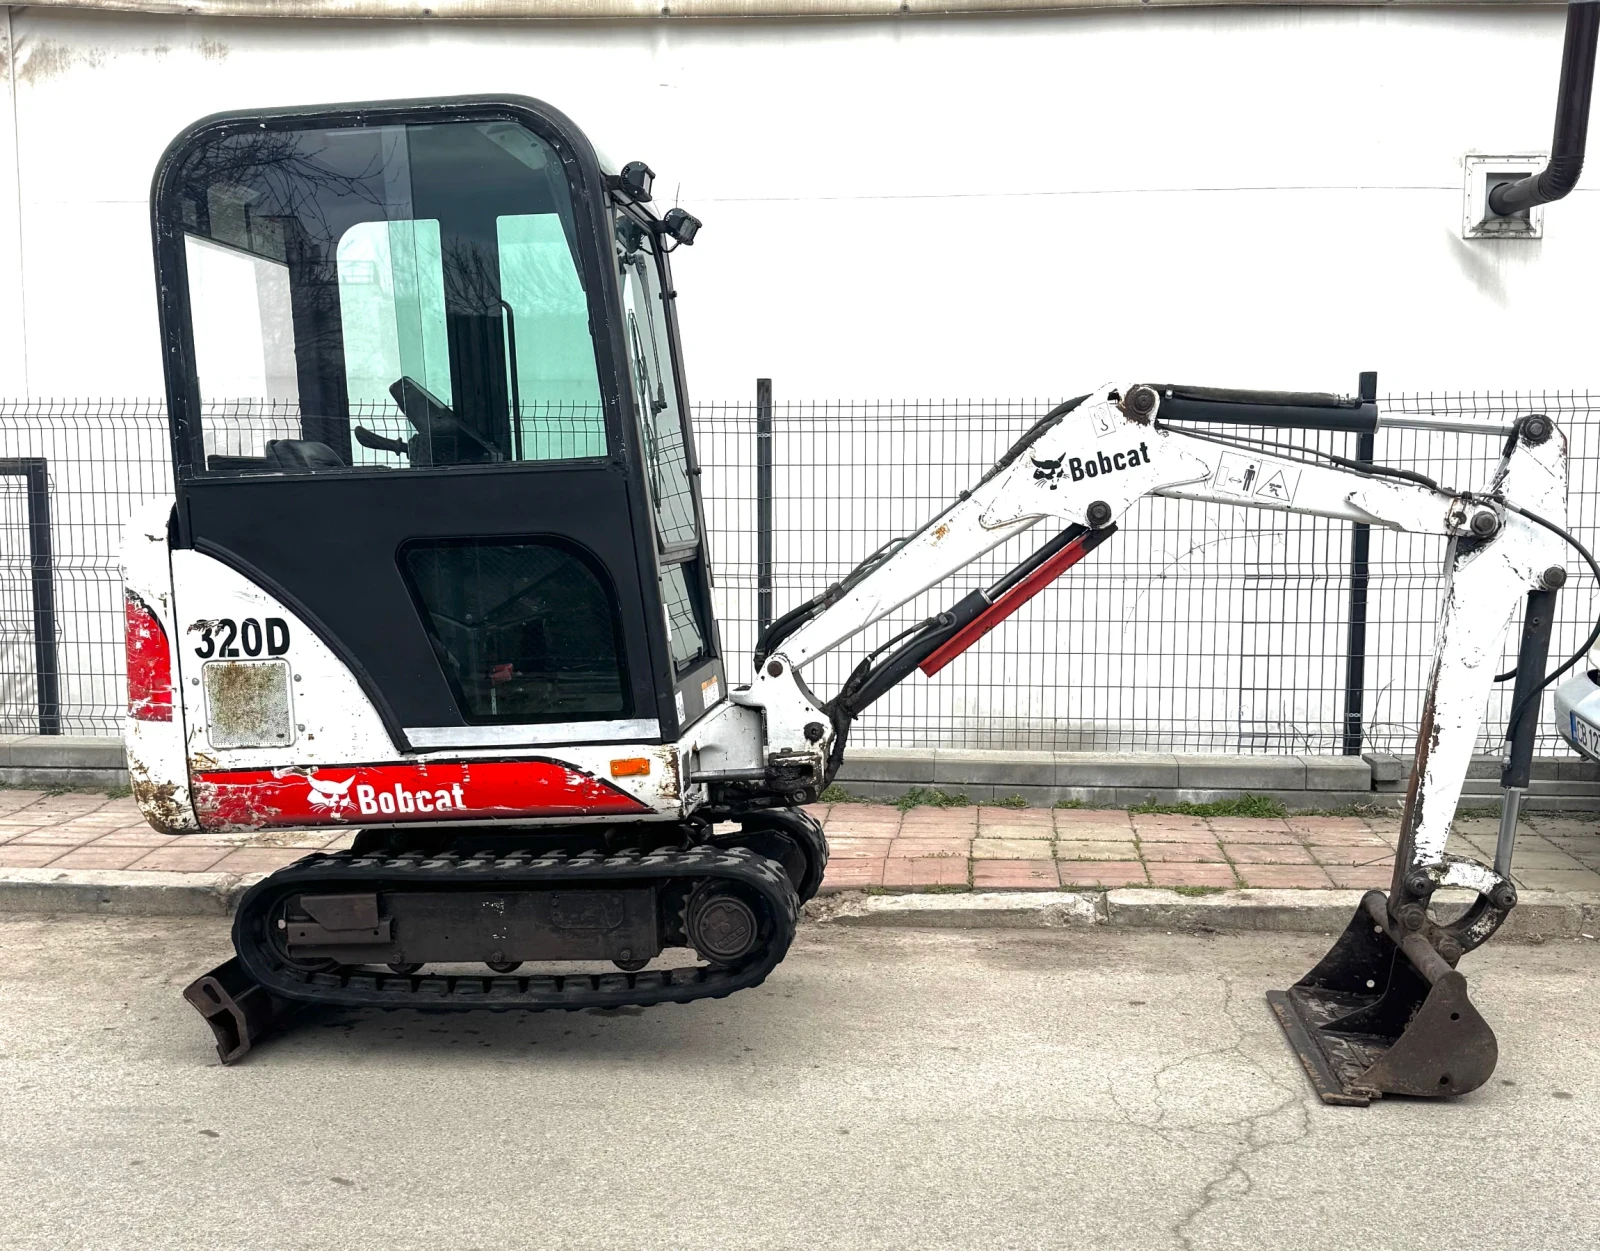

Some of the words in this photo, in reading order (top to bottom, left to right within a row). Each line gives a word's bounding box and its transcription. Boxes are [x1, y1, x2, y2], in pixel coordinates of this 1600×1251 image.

[1068, 441, 1151, 482] Bobcat
[193, 617, 290, 659] 320D
[356, 782, 467, 815] Bobcat
